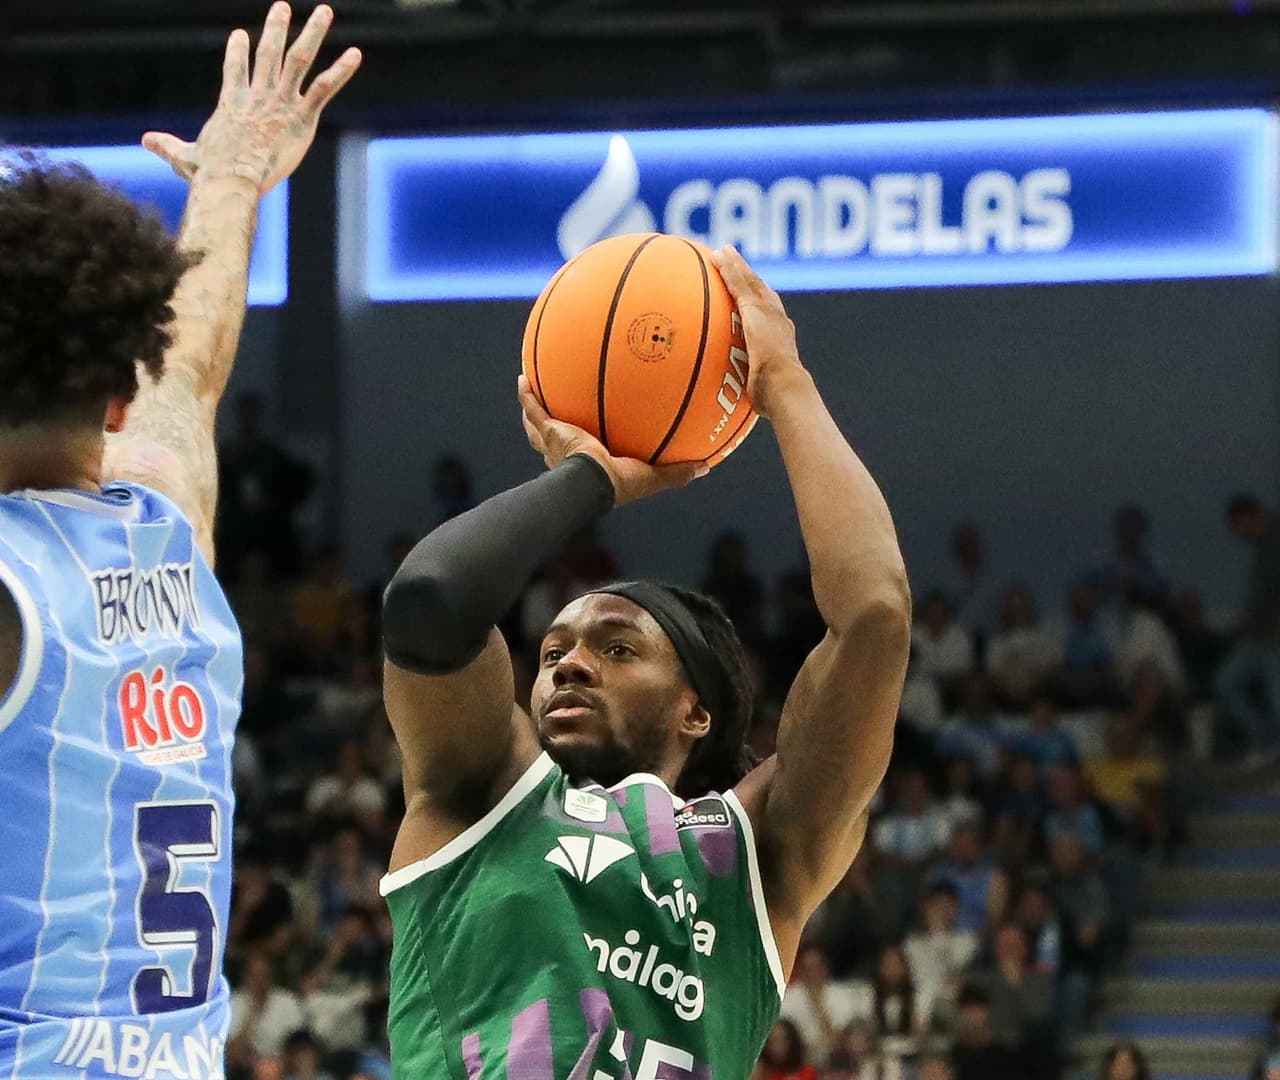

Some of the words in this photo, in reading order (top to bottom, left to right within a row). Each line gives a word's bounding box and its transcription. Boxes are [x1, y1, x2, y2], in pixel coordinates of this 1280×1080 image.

[666, 168, 1073, 257] CANDELAS
[121, 667, 204, 748] Río
[132, 799, 220, 1015] 5
